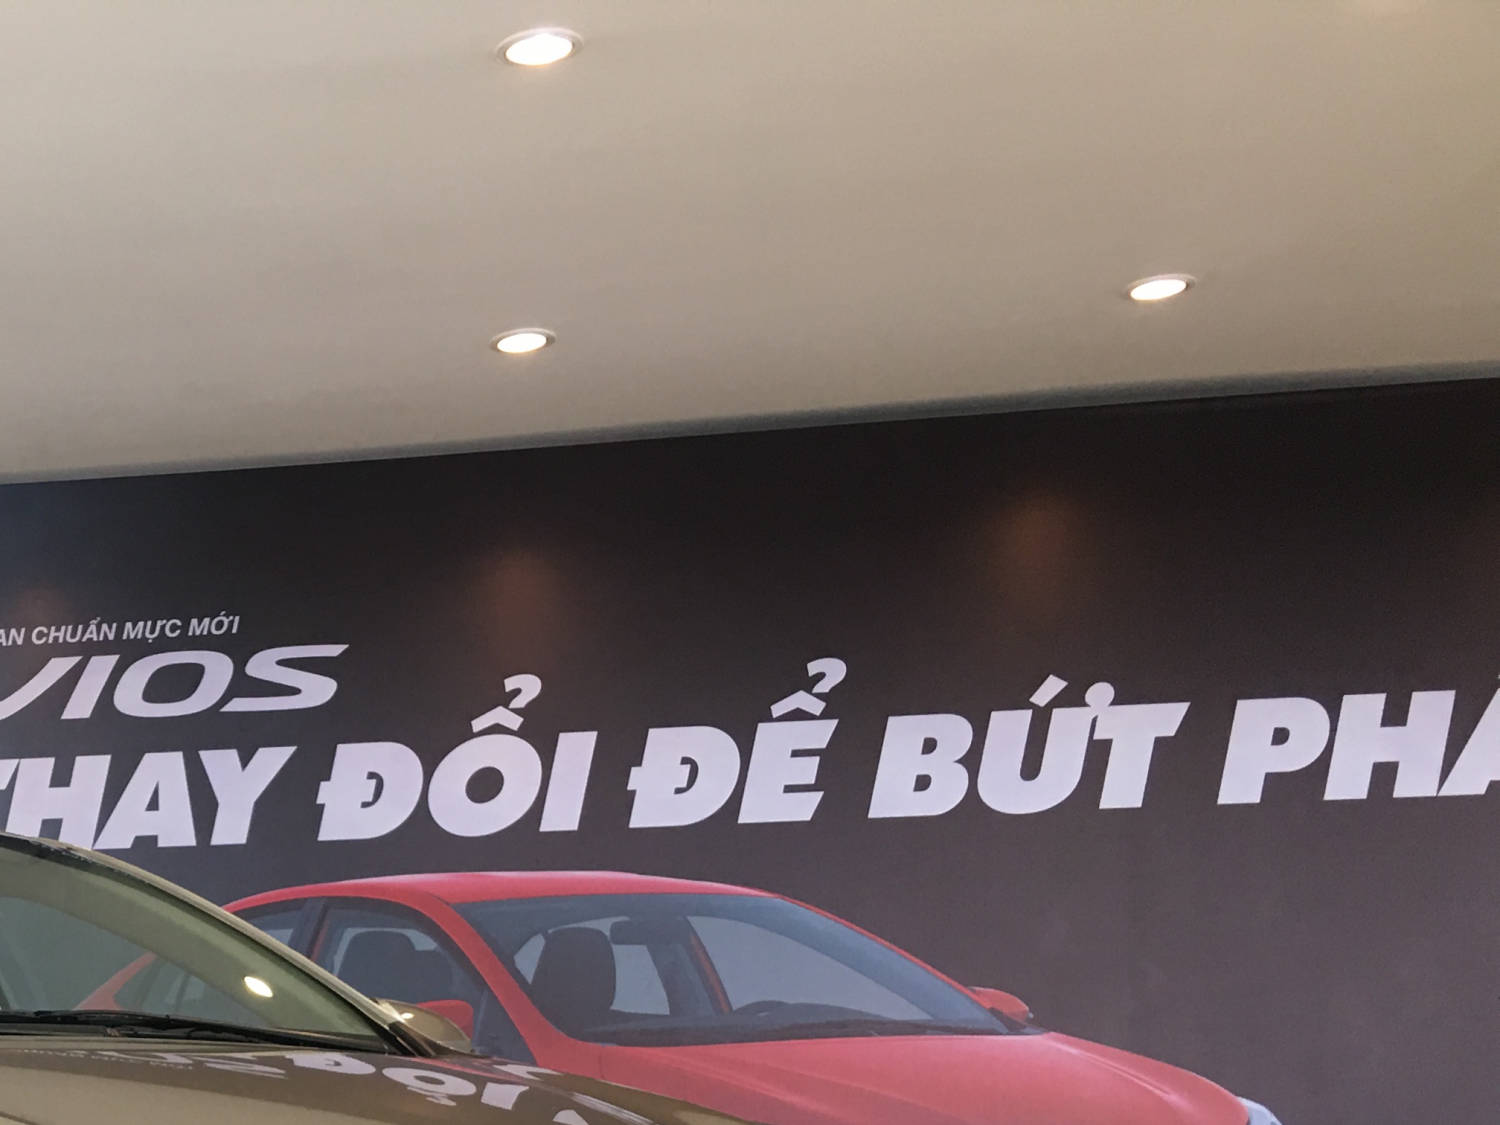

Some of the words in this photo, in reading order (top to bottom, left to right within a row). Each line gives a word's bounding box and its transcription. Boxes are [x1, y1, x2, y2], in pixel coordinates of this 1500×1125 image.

[30, 616, 118, 645] CHUẨN
[122, 619, 182, 643] MỰC
[187, 611, 241, 637] MỚI
[316, 673, 598, 841] ĐỔI
[627, 657, 848, 828] ĐỂ
[867, 673, 1191, 815] BỨT
